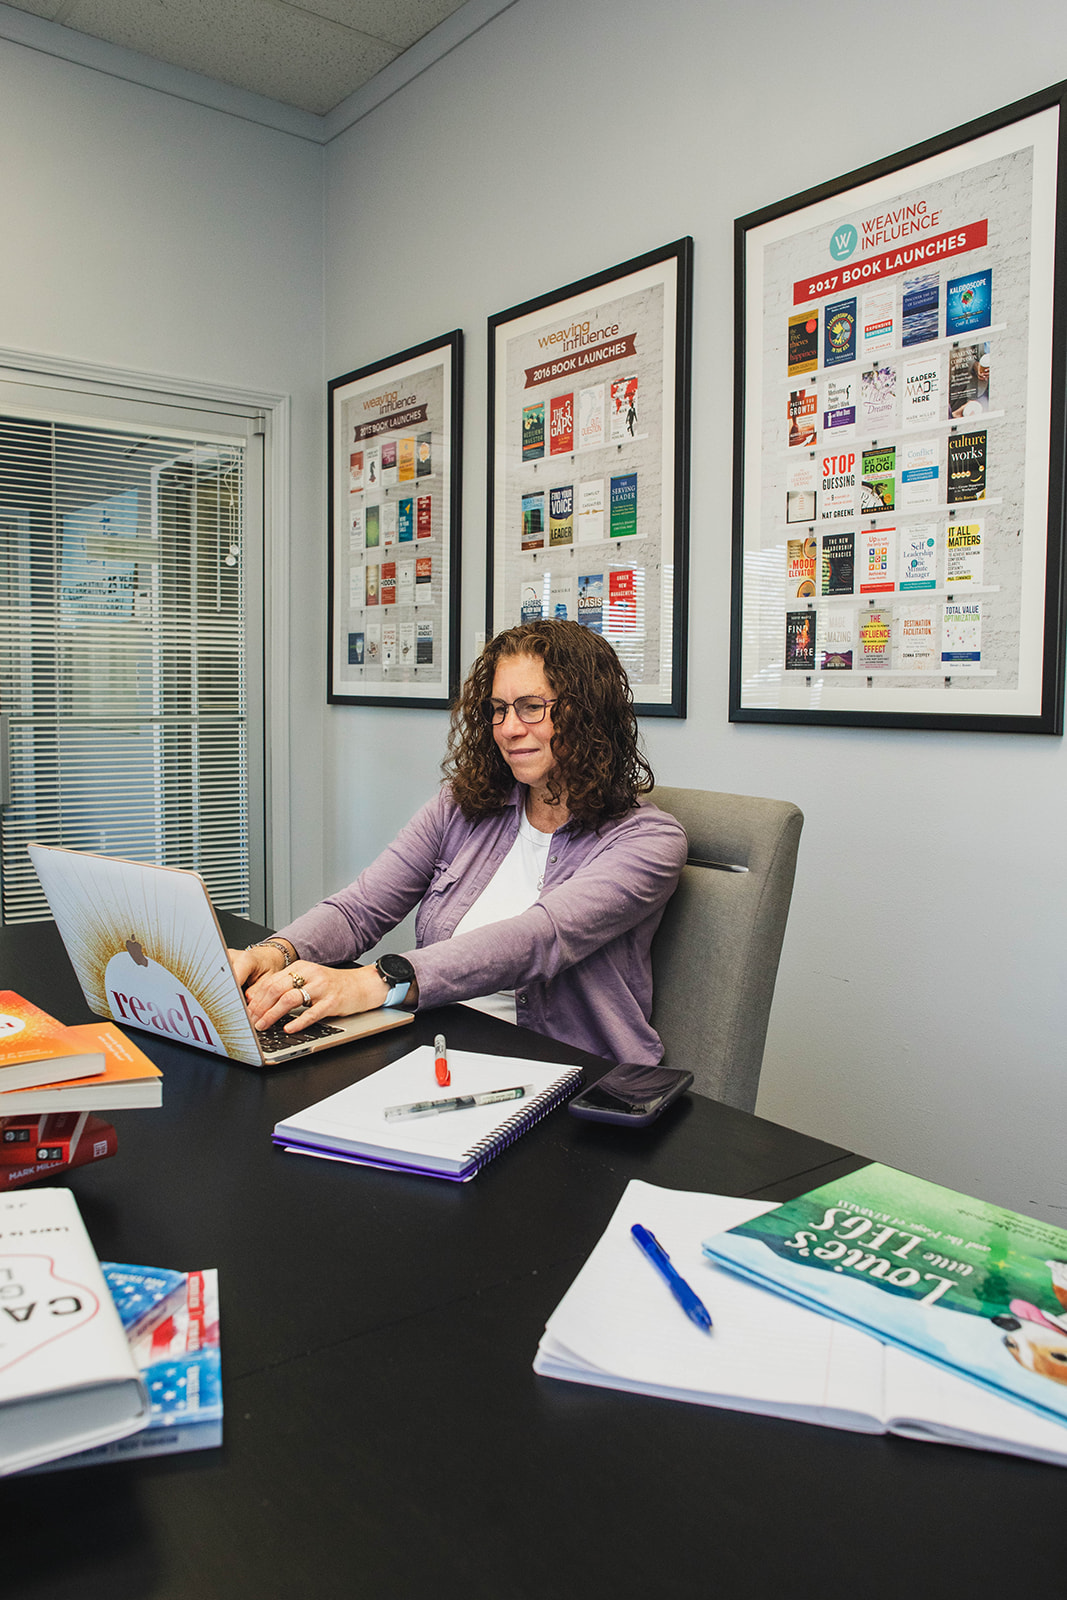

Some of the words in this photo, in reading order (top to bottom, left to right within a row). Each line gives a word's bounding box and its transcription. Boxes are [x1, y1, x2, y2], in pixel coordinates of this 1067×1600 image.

[862, 201, 927, 234] WEAVING
[862, 212, 940, 250] INFLUENCE
[808, 276, 838, 294] 2017
[843, 263, 882, 284] BOOK
[886, 233, 967, 270] LAUNCHES
[950, 278, 986, 294] KALEIDOSCOPE
[866, 321, 891, 331] EXPENSIVE
[538, 321, 590, 348] weaving
[563, 324, 619, 352] influence
[533, 367, 551, 381] 2016
[552, 358, 576, 375] BOOK
[578, 342, 627, 366] LAUNCHES
[907, 372, 936, 384] LEADERS
[363, 391, 398, 410] weaving
[380, 395, 416, 415] influence
[912, 395, 930, 404] HERE
[553, 408, 563, 419] THE
[790, 404, 815, 416] GROWTH
[372, 420, 389, 433] BOOK
[389, 410, 421, 428] LAUNCHES
[551, 415, 572, 437] GAPS
[949, 435, 986, 449] culture
[908, 448, 933, 458] Conflict
[951, 447, 983, 461] works
[823, 453, 855, 476] STOP
[864, 461, 893, 474] FROG!
[823, 474, 855, 490] GUESSING
[612, 485, 635, 495] SERVING
[612, 493, 635, 502] LEADER
[551, 498, 573, 514] VOICE
[834, 509, 854, 518] GREENE
[551, 527, 572, 540] LEADER
[948, 527, 955, 537] IT
[957, 526, 971, 535] ALL
[911, 541, 924, 550] Self
[948, 535, 981, 547] MATTERS
[793, 559, 815, 570] MOOD
[789, 568, 814, 578] ELEVATOR
[579, 597, 602, 608] OASIS
[946, 606, 961, 614] TOTAL
[962, 605, 979, 614] VALUE
[870, 615, 881, 623] THE
[944, 614, 980, 622] OPTIMIZATION
[788, 625, 808, 633] FIND
[859, 629, 891, 638] INFLUENCE
[796, 648, 814, 657] FIRE
[864, 645, 885, 653] EFFECT
[111, 990, 217, 1047] reach
[9, 1168, 35, 1181] MARK
[36, 1162, 67, 1172] MILL
[809, 1207, 926, 1260] LEGS
[784, 1230, 959, 1308] Louie's
